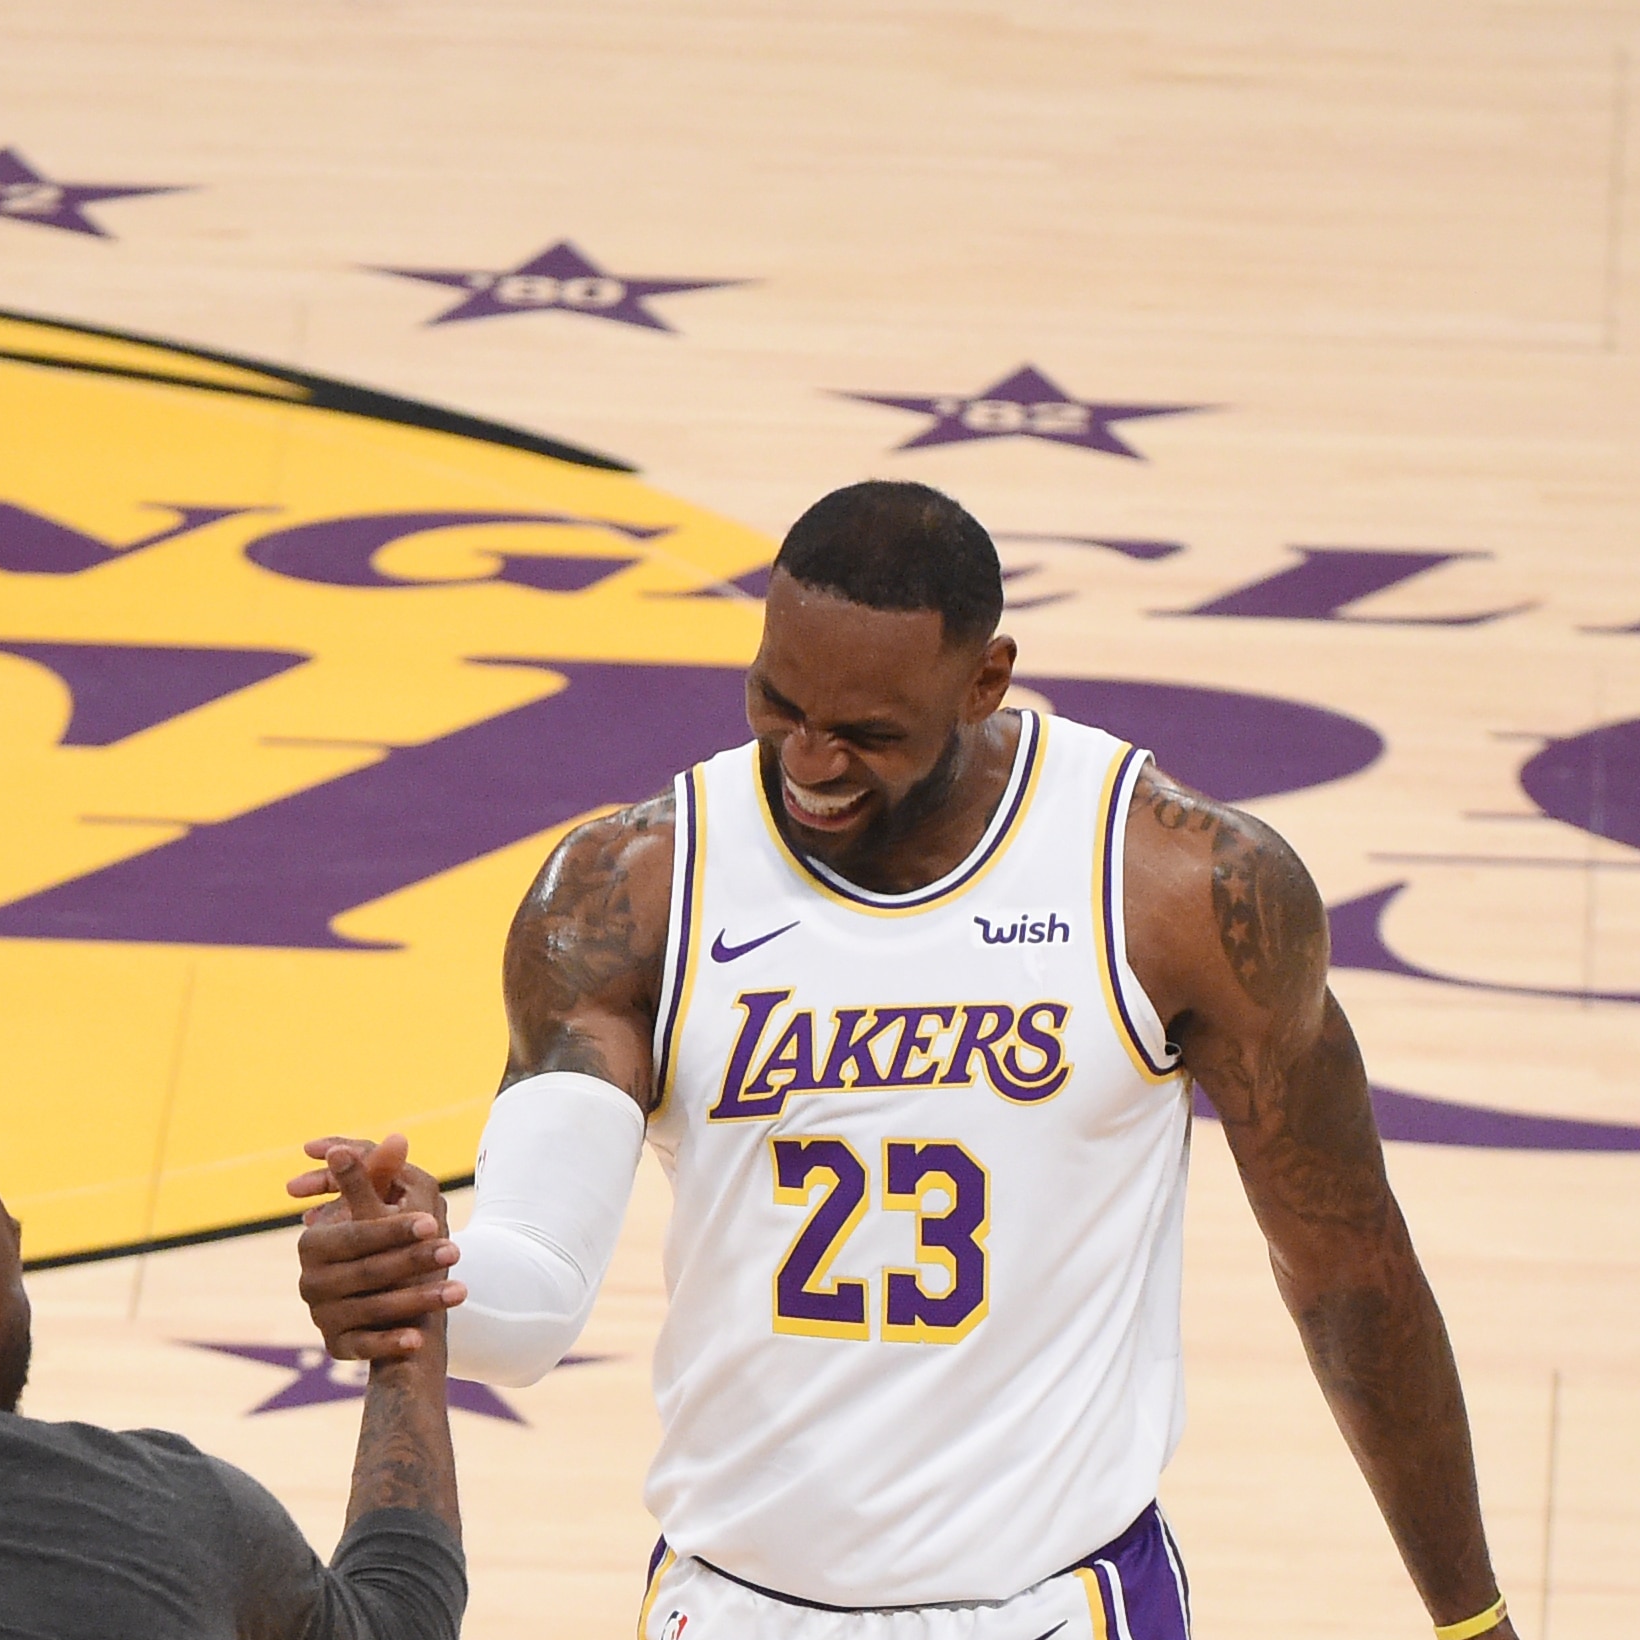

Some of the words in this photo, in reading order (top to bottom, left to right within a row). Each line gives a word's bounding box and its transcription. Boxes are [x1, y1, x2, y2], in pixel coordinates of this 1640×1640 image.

[470, 273, 626, 308] '80
[973, 913, 1070, 944] wish
[706, 986, 1075, 1124] LAKERS
[769, 1135, 991, 1345] 23
